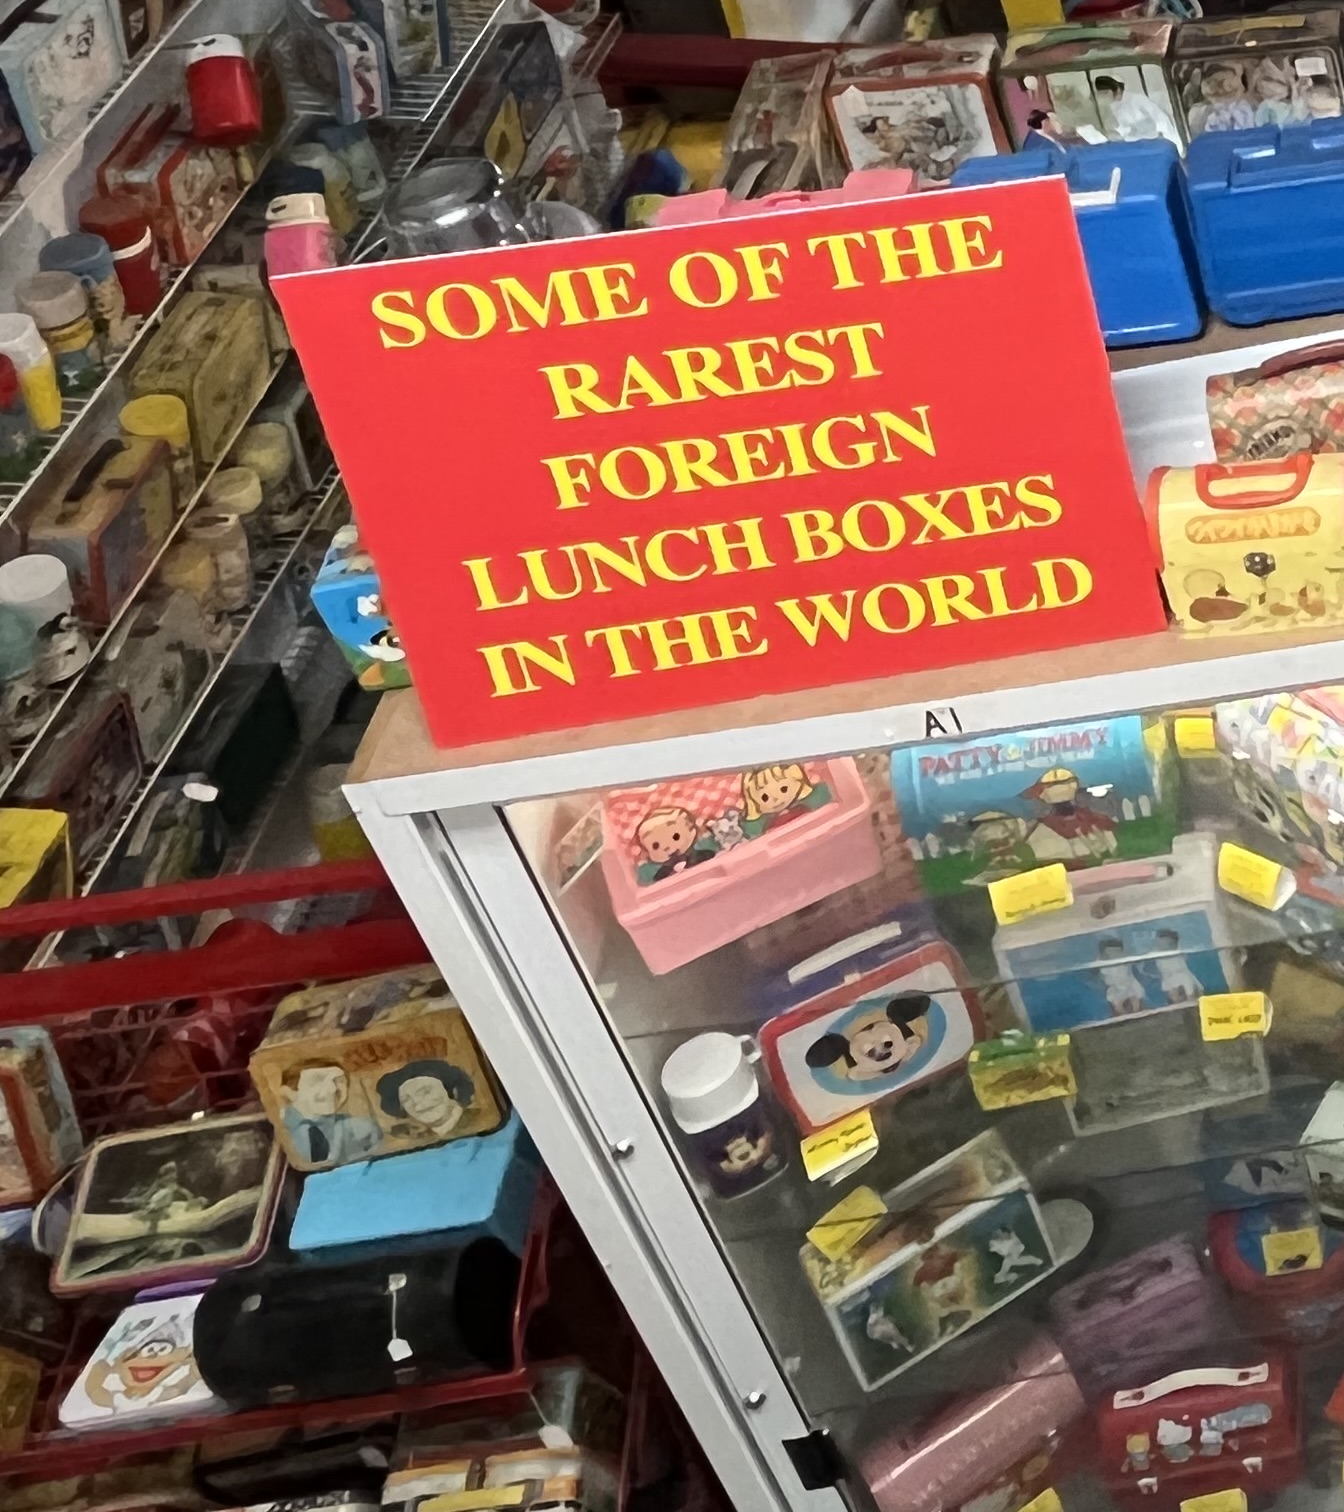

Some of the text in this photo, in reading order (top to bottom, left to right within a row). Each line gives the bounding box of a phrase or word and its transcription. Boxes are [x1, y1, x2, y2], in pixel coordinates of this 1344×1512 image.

[369, 215, 1004, 349] SOME OF THE
[540, 322, 887, 420] RAREST
[543, 405, 938, 510] FOREIGN
[462, 474, 1064, 612] LUNCH BOXES
[477, 556, 1095, 698] IN THE WORLD
[919, 744, 1000, 777] PATTY
[1027, 727, 1109, 756] JIMMY
